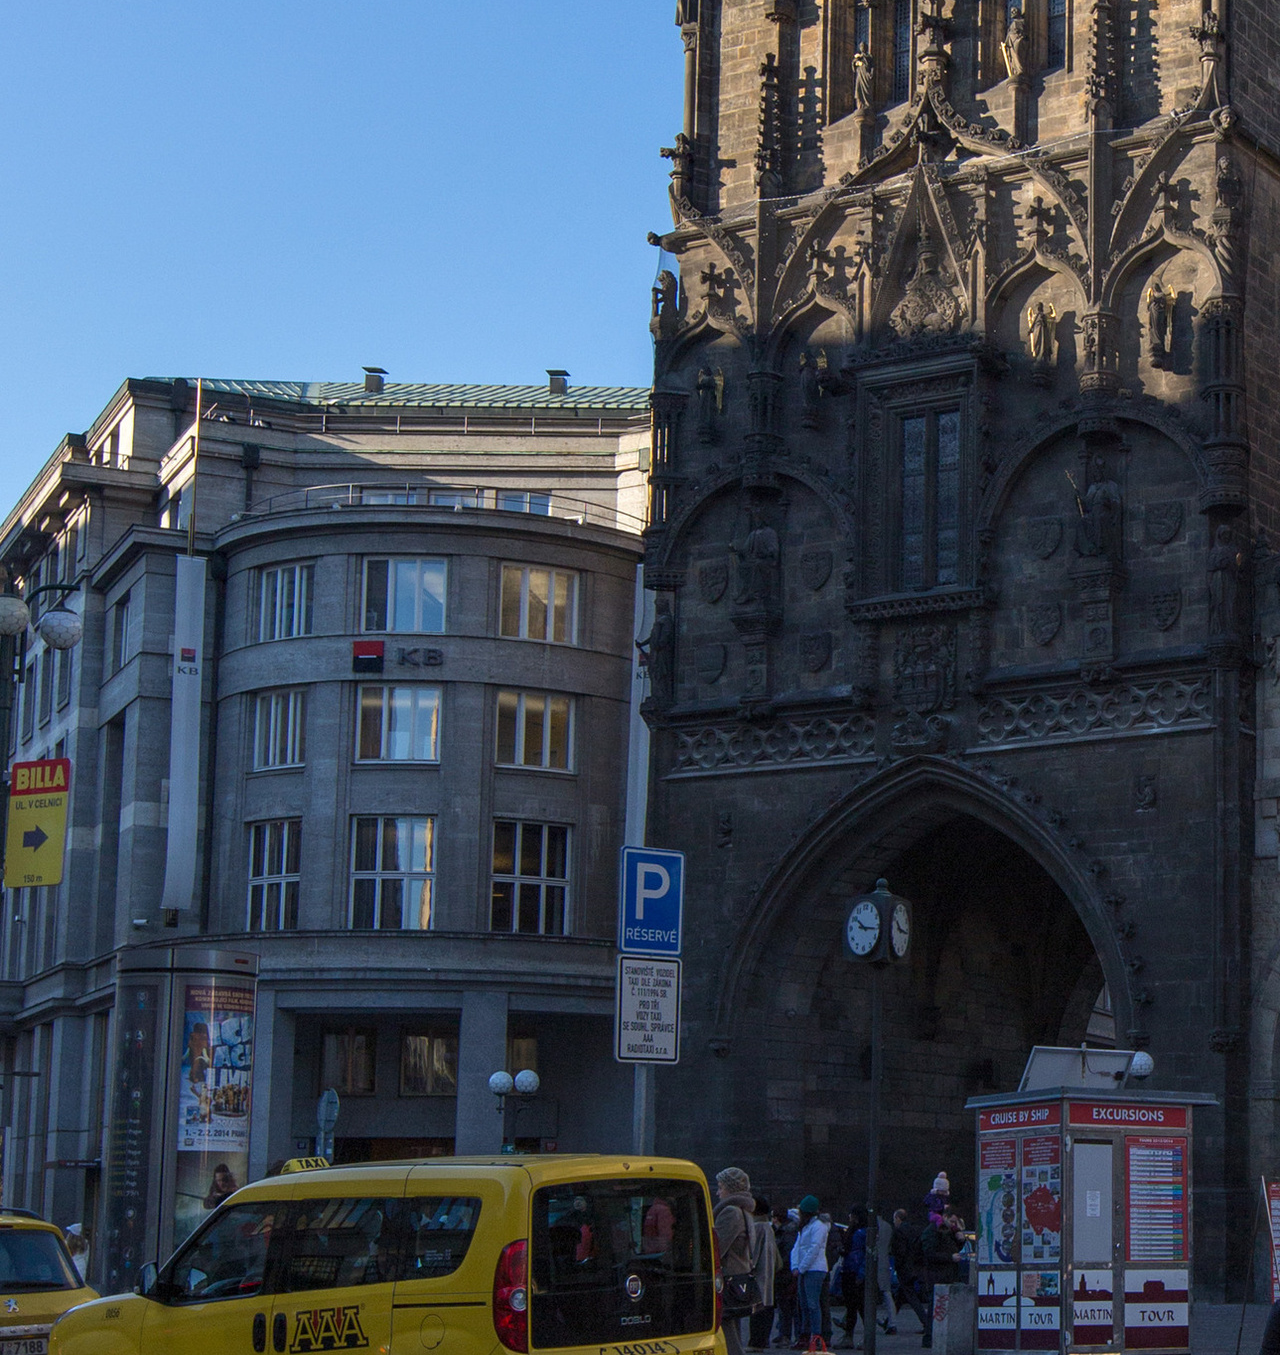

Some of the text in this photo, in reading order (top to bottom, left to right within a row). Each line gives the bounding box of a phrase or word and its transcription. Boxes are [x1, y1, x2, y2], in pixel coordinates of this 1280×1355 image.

[397, 647, 444, 666] KB
[177, 666, 199, 675] KB
[16, 765, 65, 791] BILLA
[34, 798, 63, 808] CELNICI
[23, 874, 35, 883] 150
[635, 862, 670, 920] P
[626, 926, 677, 943] RÉSERVÉ
[990, 1108, 1050, 1124] CRUISE BY SHIP
[1092, 1107, 1164, 1122] EXCURSIONS
[214, 1129, 229, 1137] 2014
[297, 1158, 326, 1170] TAXI
[979, 1313, 1016, 1325] MARTIN
[1029, 1313, 1053, 1325] TOUR
[1074, 1309, 1113, 1321] MARTIN
[1139, 1309, 1175, 1322] TOUR
[290, 1305, 369, 1354] AAA
[14, 1341, 44, 1355] 7188
